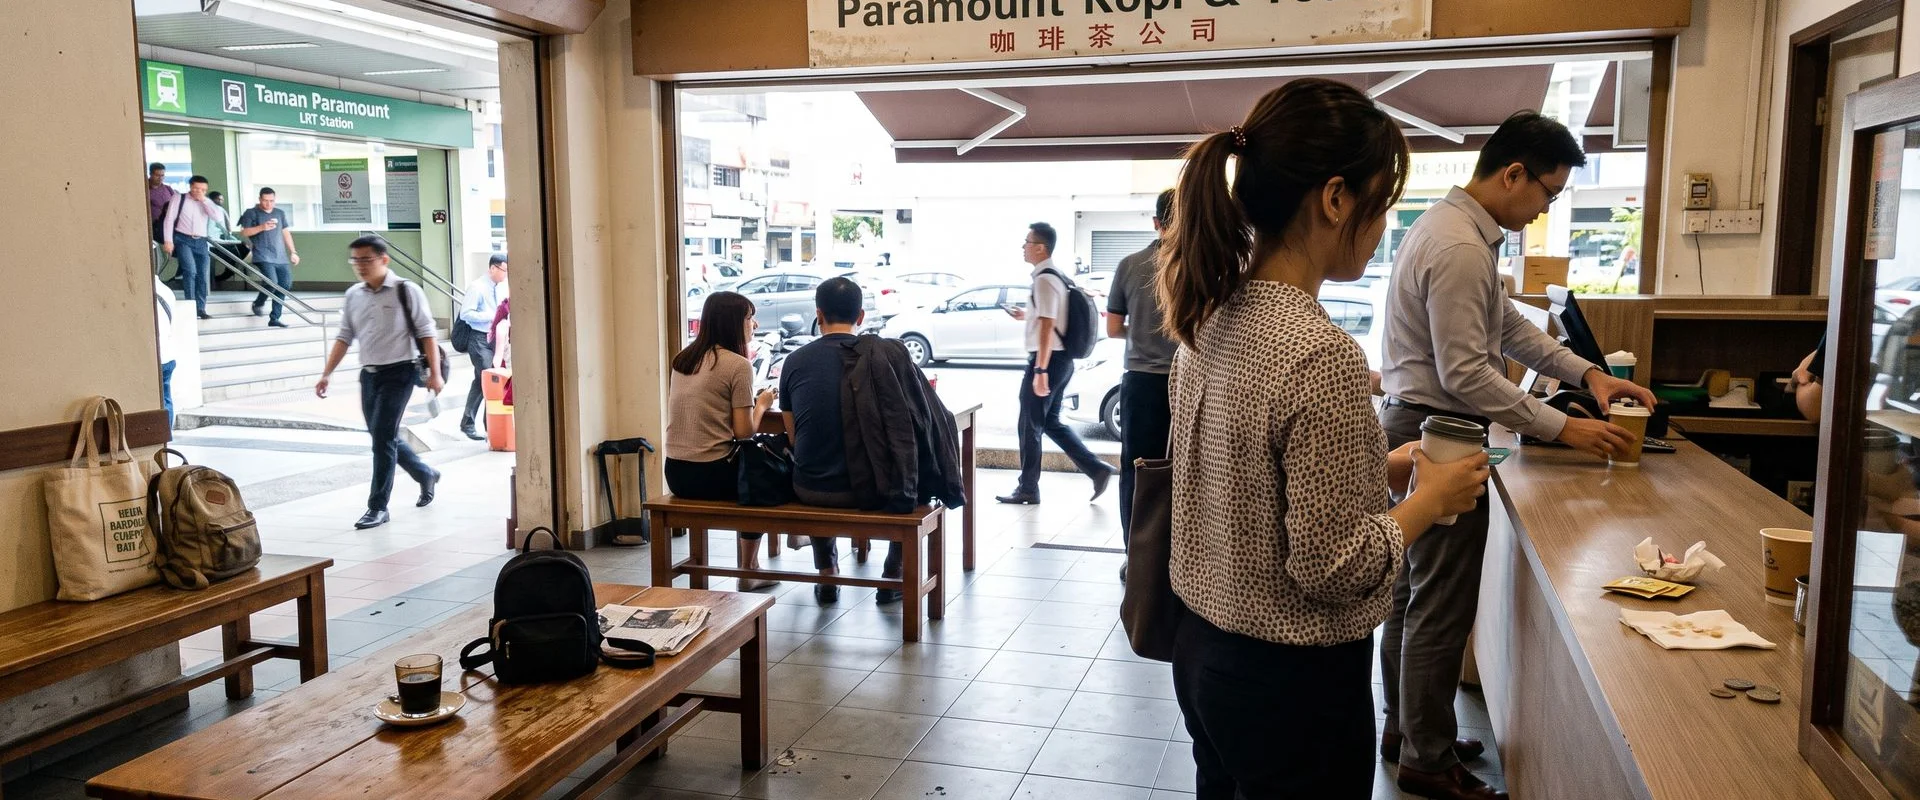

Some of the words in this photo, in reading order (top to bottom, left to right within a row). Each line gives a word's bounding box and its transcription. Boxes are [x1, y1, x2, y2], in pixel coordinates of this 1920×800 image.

[838, 0, 1064, 28] Paramount
[1085, 0, 1182, 19] op
[254, 84, 308, 109] Taman
[311, 92, 390, 119] Paramount
[299, 112, 318, 126] LRT
[319, 114, 354, 130] Station
